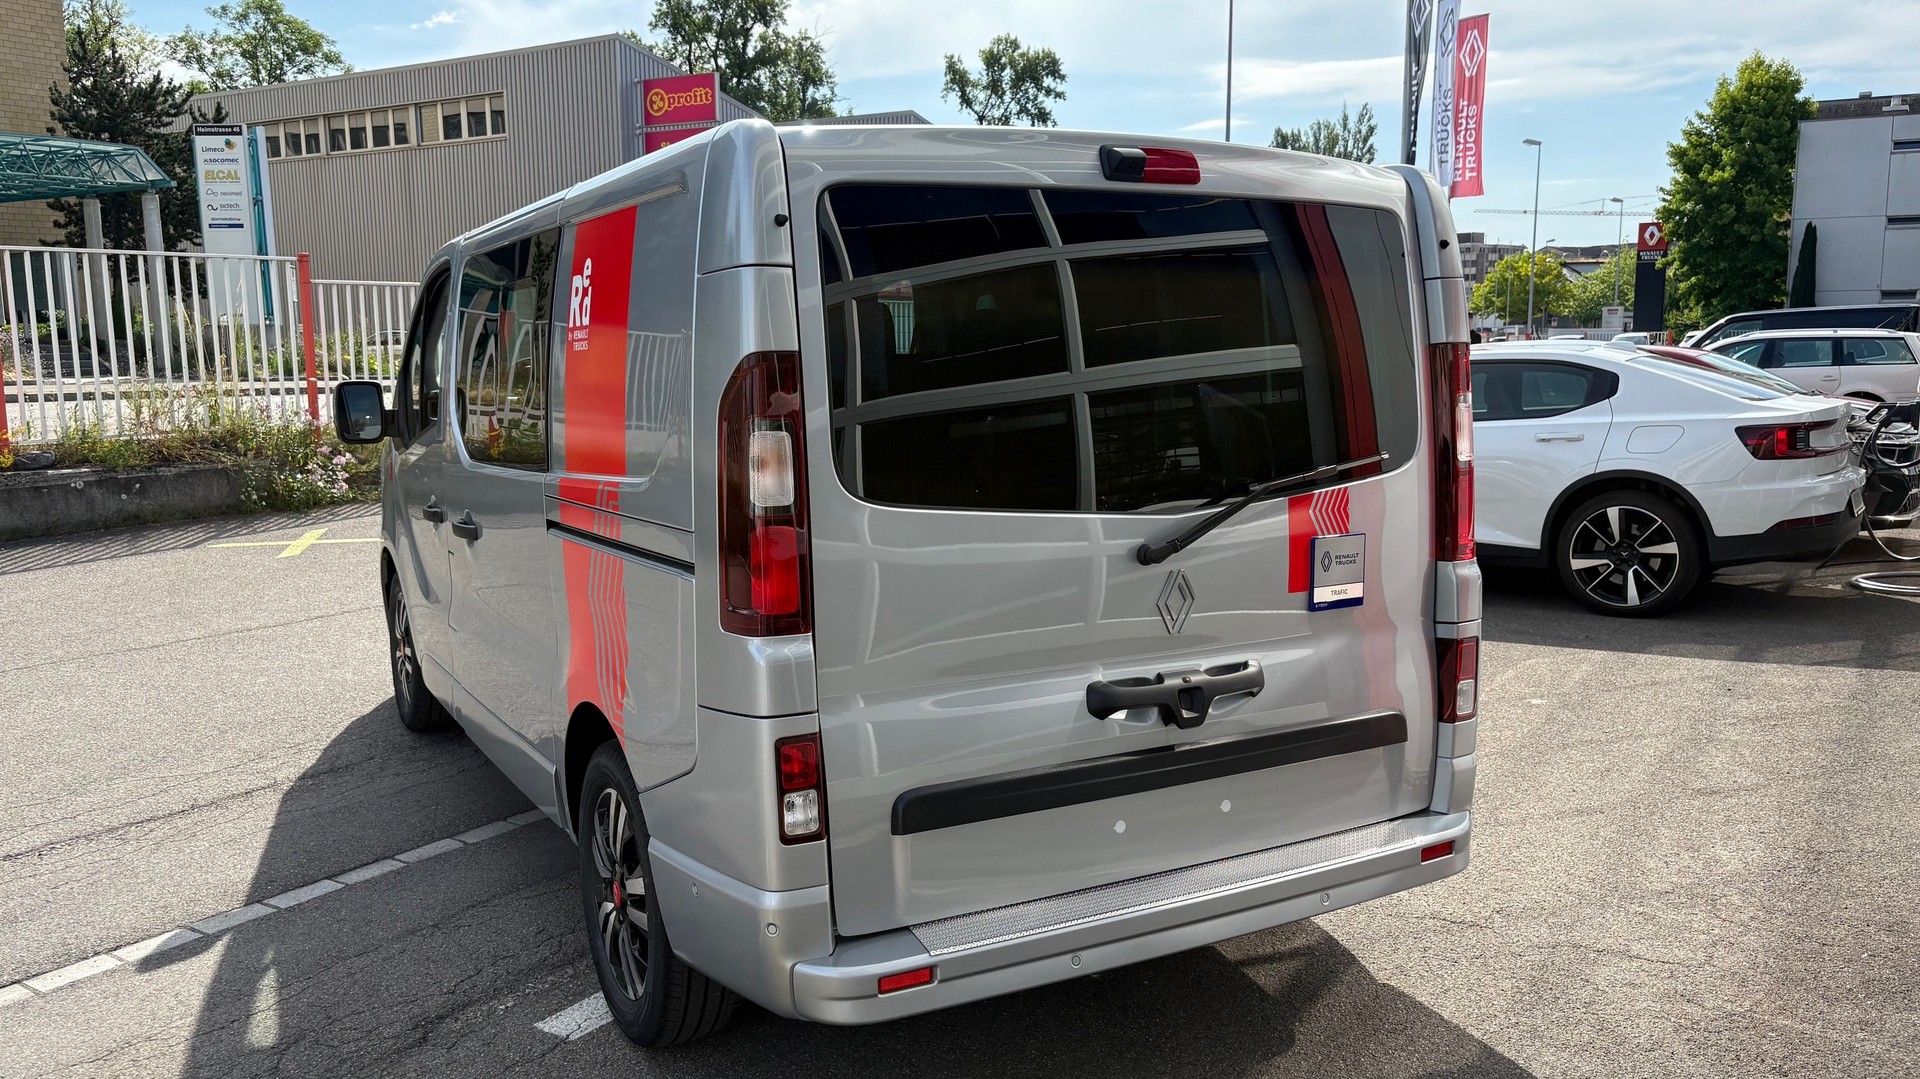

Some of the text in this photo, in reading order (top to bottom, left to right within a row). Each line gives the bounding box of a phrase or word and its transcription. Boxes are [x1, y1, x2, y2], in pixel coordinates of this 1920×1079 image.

[667, 88, 712, 110] profit
[1438, 88, 1452, 168] TRUCKS
[1454, 98, 1468, 181] RENAULT
[1465, 104, 1477, 181] TRUCKS
[204, 169, 241, 181] ELCAL
[573, 328, 589, 340] RENAULT
[573, 340, 589, 351] TRUCKS
[1334, 552, 1359, 561] RENAULT
[1334, 558, 1357, 566] TRUCKS
[1331, 588, 1349, 597] TRAFIC
